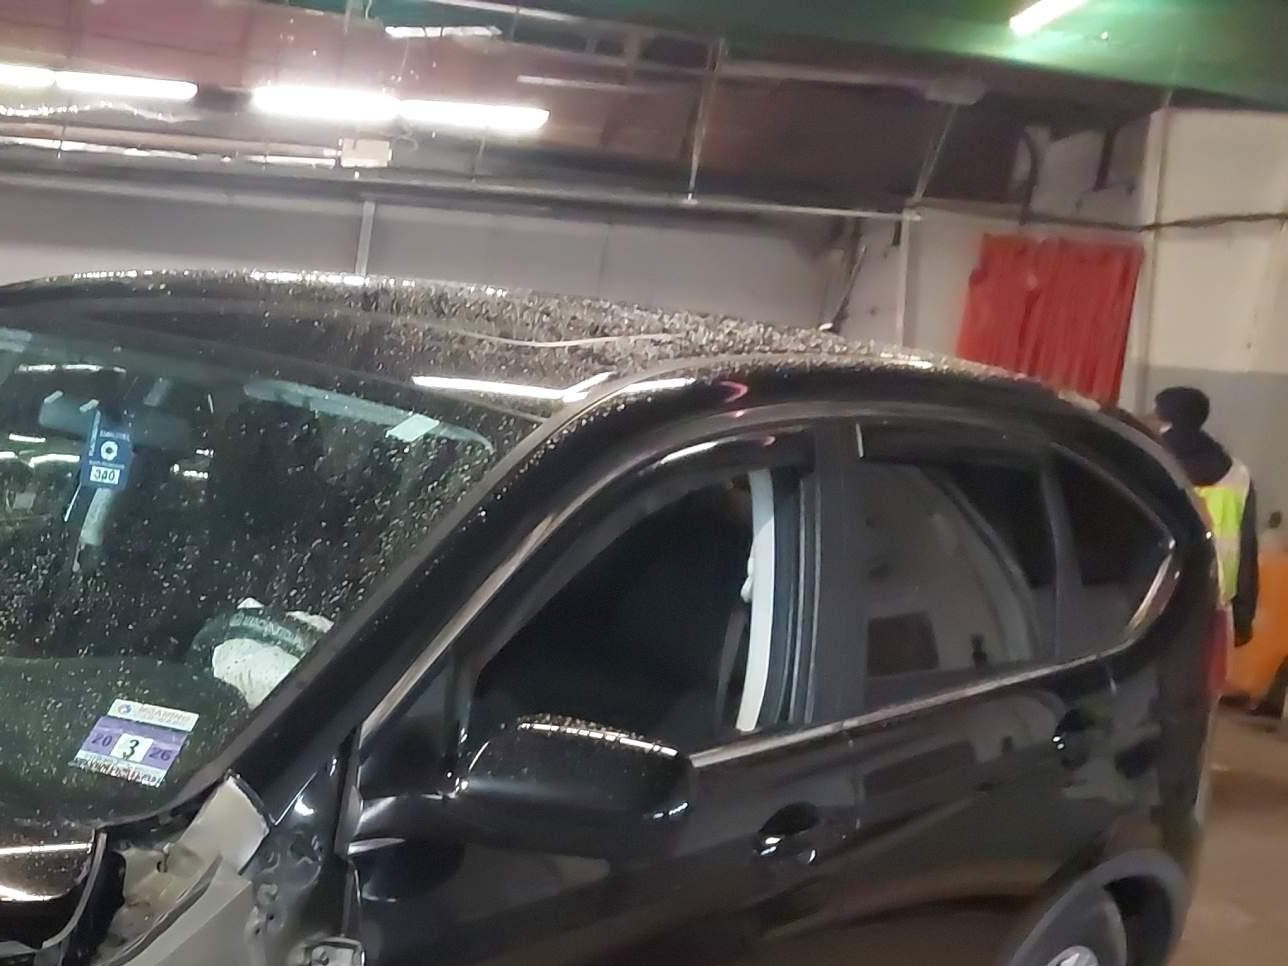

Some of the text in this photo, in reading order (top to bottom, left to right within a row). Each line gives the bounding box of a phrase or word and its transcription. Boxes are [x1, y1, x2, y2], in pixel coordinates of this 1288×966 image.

[91, 733, 173, 762] 20 3 26
